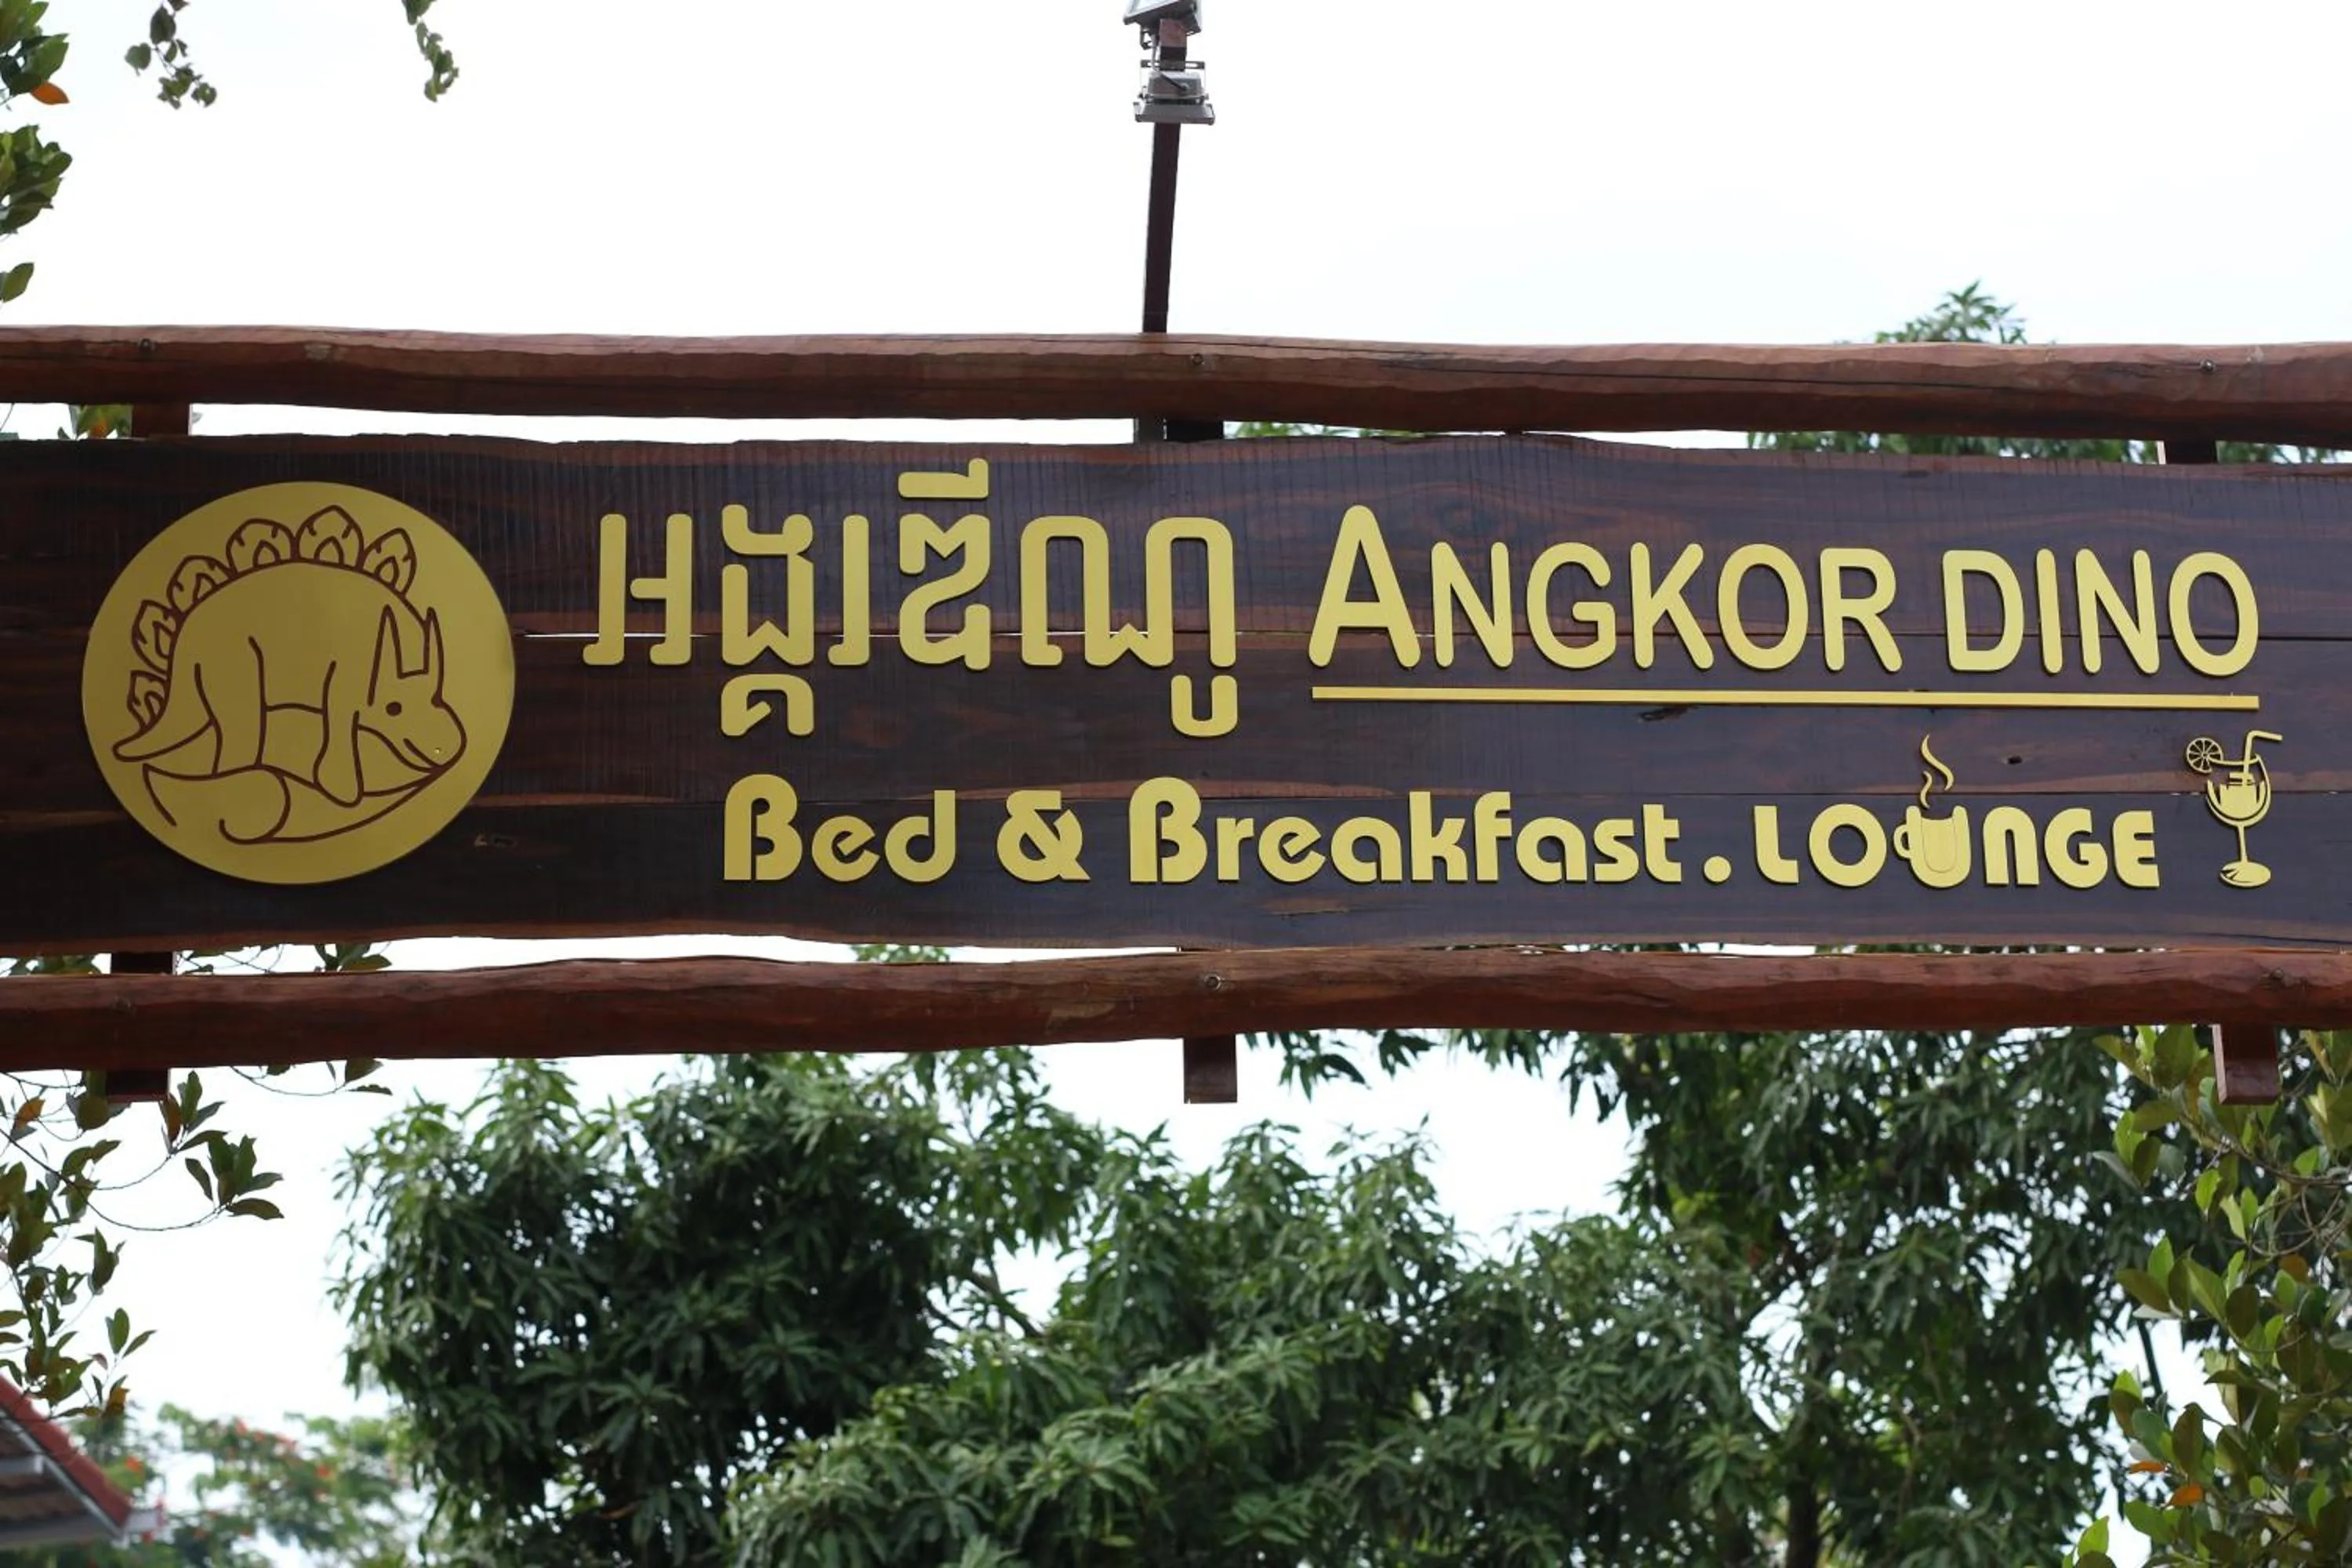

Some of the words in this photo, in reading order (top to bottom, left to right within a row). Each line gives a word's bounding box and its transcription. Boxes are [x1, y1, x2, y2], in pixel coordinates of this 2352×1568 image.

[582, 457, 1239, 737] អង្គរឌីណូ
[1308, 504, 1903, 672] ANGKOR
[1942, 548, 2259, 676] DINO
[723, 773, 956, 883] Bed
[996, 789, 1091, 883] &
